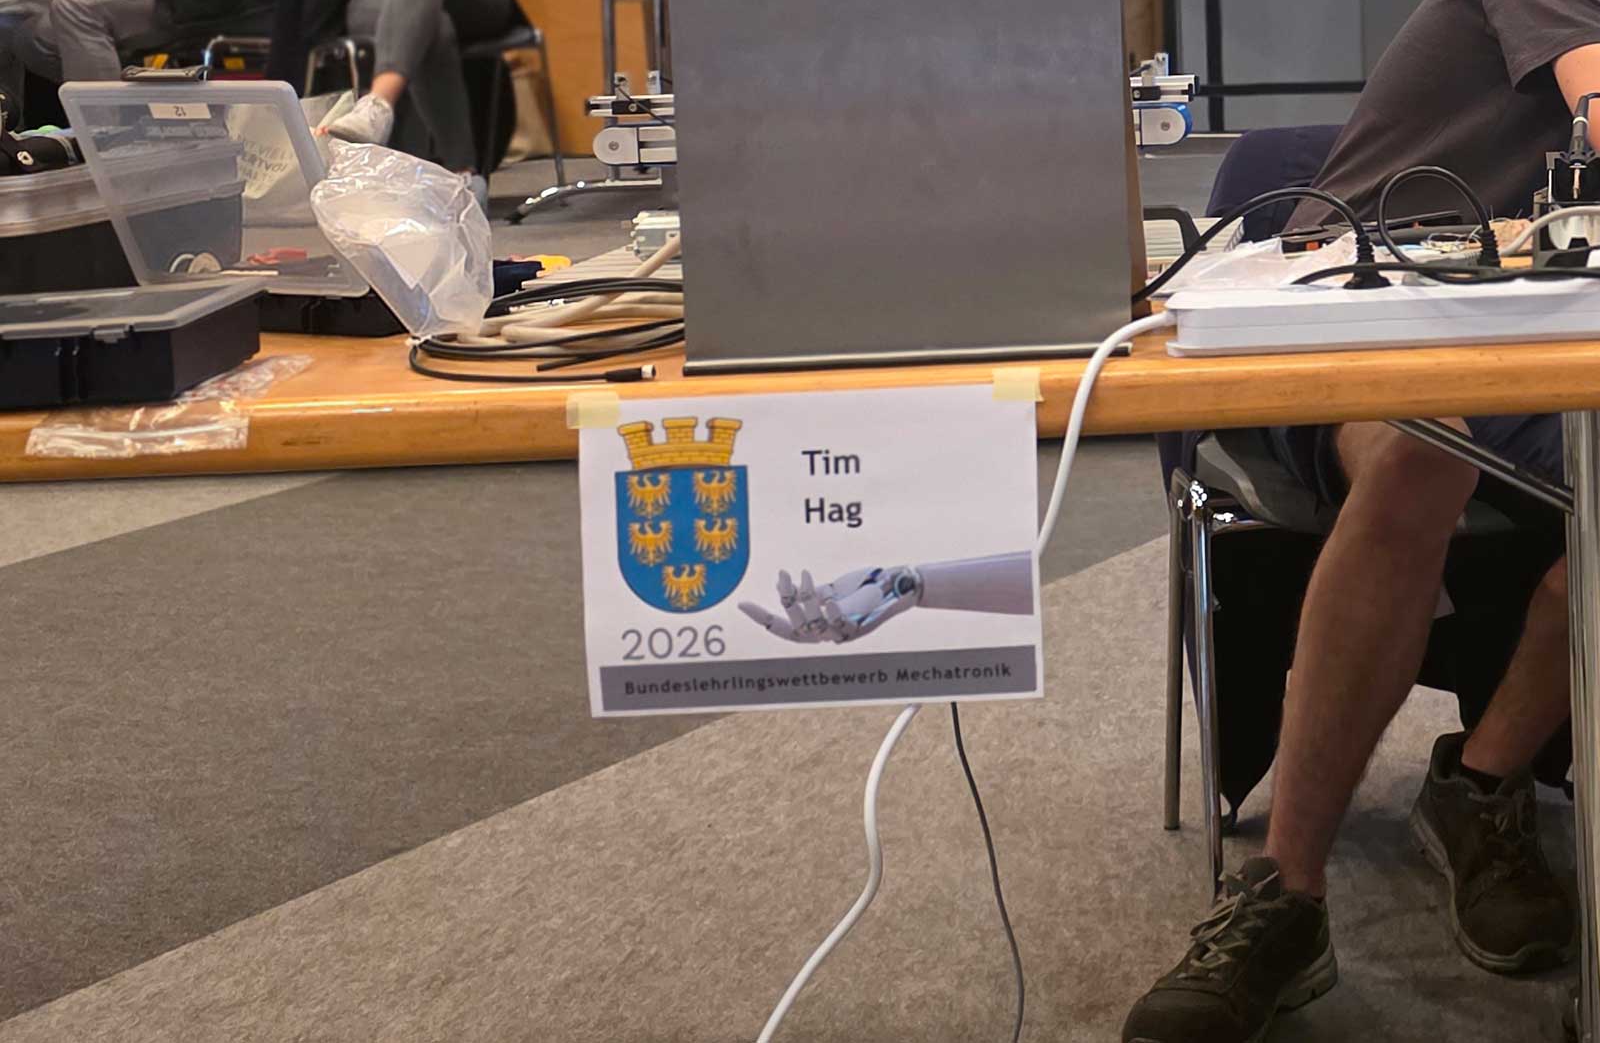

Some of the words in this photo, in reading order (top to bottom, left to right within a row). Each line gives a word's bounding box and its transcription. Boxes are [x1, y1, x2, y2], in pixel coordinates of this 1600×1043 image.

[801, 449, 861, 476] Tim
[804, 497, 863, 529] Hag
[621, 624, 726, 660] 2026
[624, 669, 889, 696] Bundeslehrlingswettbewerb
[896, 662, 1012, 683] Mechatronik
